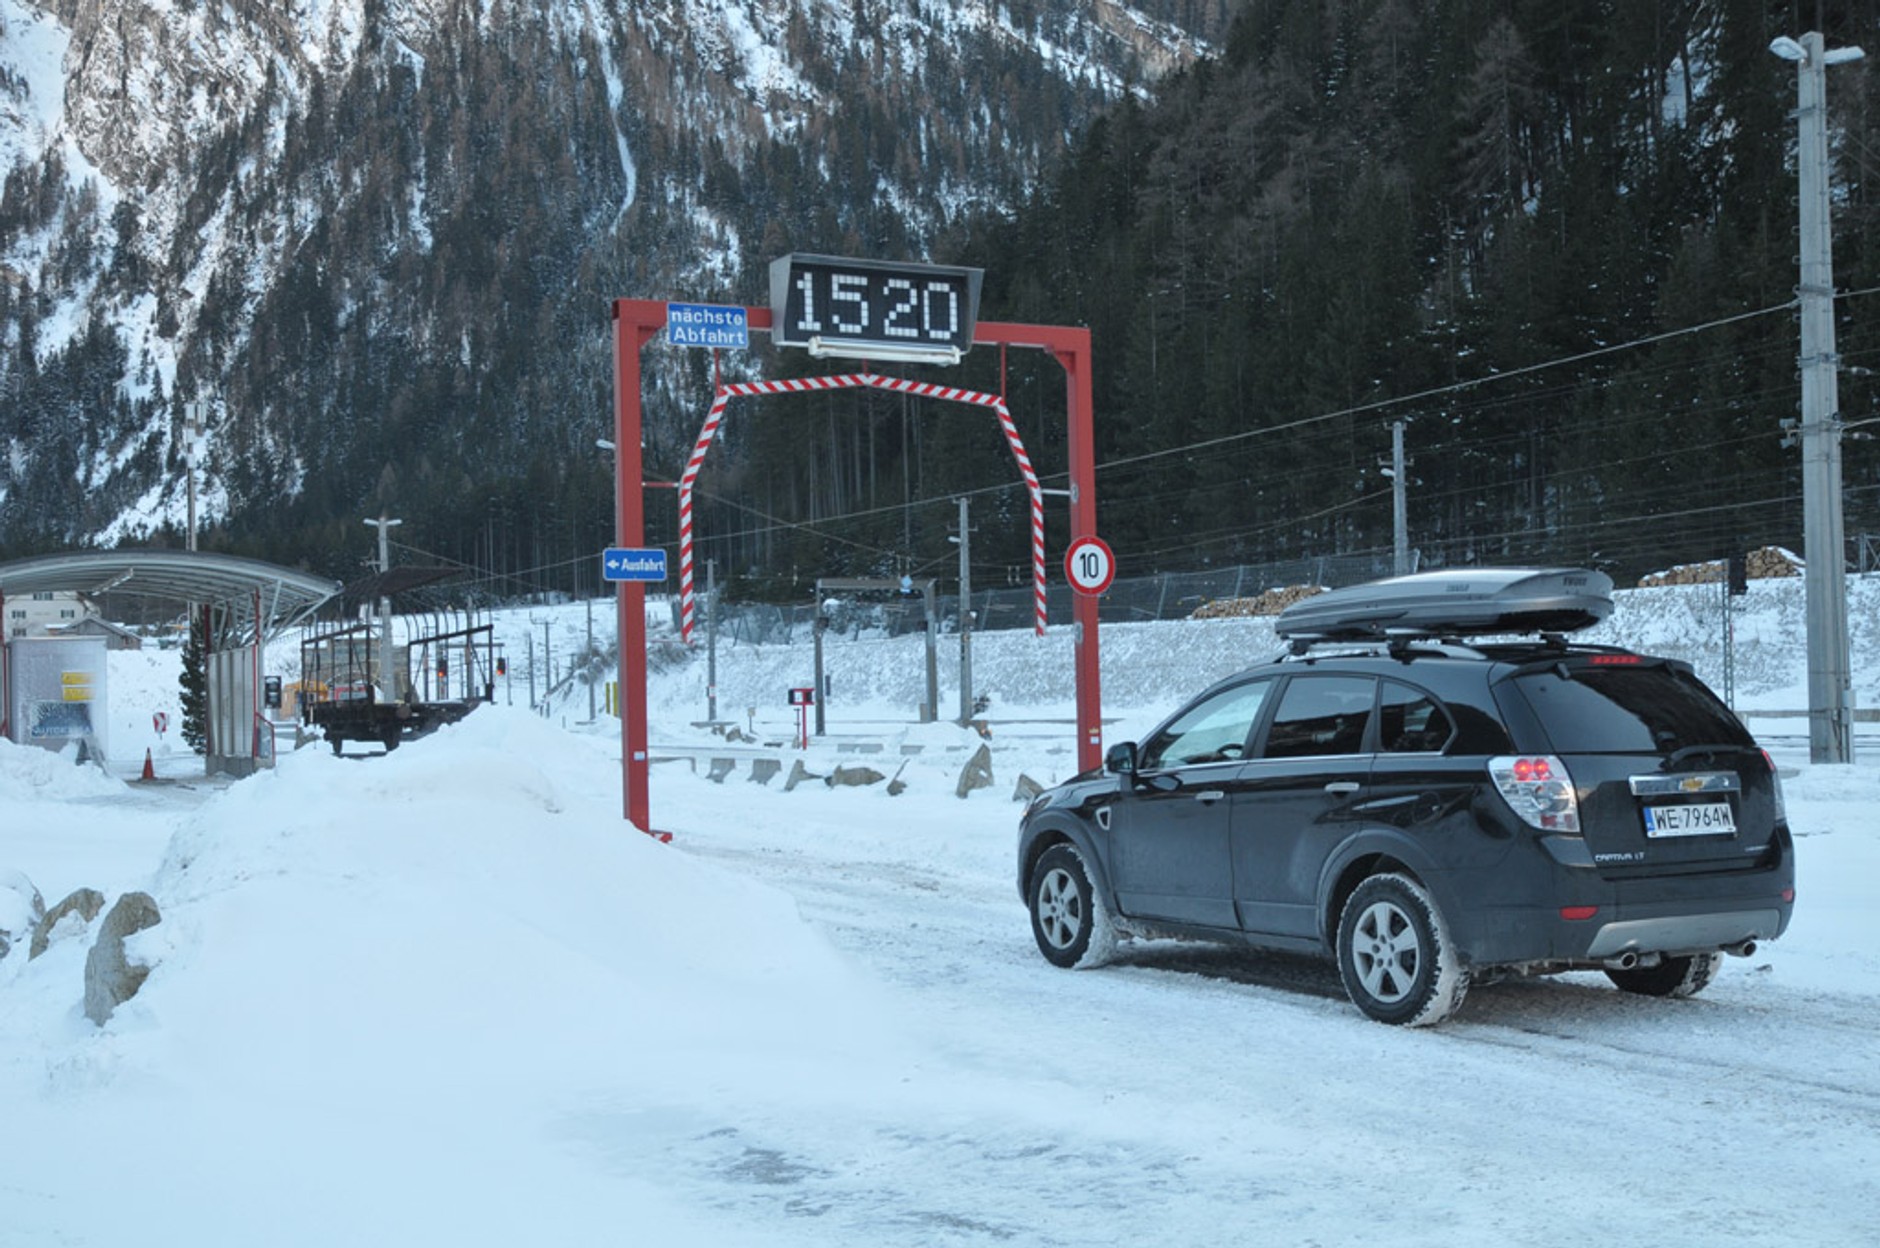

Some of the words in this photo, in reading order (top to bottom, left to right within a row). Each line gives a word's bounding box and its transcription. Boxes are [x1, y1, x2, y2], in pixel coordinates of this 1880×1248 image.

[671, 307, 744, 326] nächste
[673, 326, 745, 345] Abfahrt
[620, 557, 665, 572] Ausfahrt
[1079, 552, 1099, 579] 10
